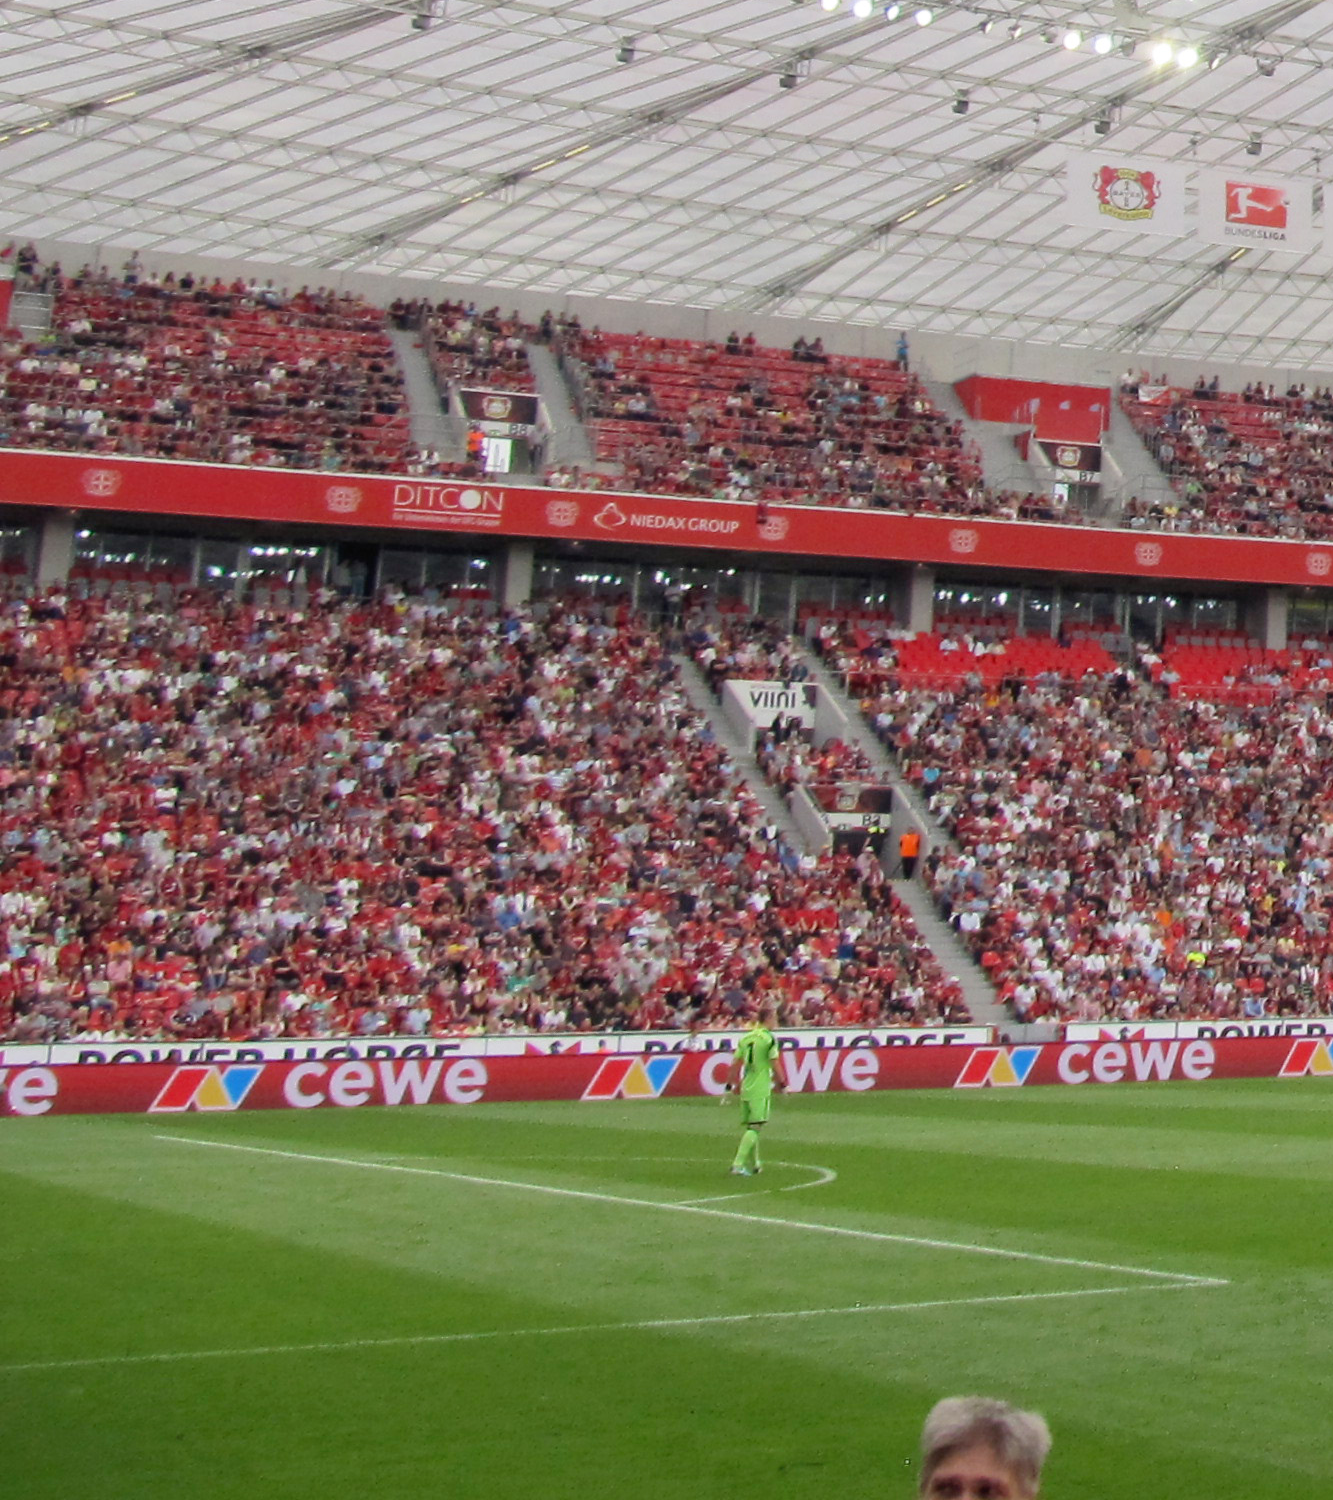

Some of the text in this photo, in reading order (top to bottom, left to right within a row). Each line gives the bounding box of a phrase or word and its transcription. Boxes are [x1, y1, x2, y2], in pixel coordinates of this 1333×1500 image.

[1225, 226, 1286, 241] BUNDESLIGA
[631, 513, 739, 533] NIEDAX GROUP
[283, 1057, 488, 1109] cewe
[700, 1048, 880, 1096] cwe
[1057, 1040, 1216, 1085] cewe
